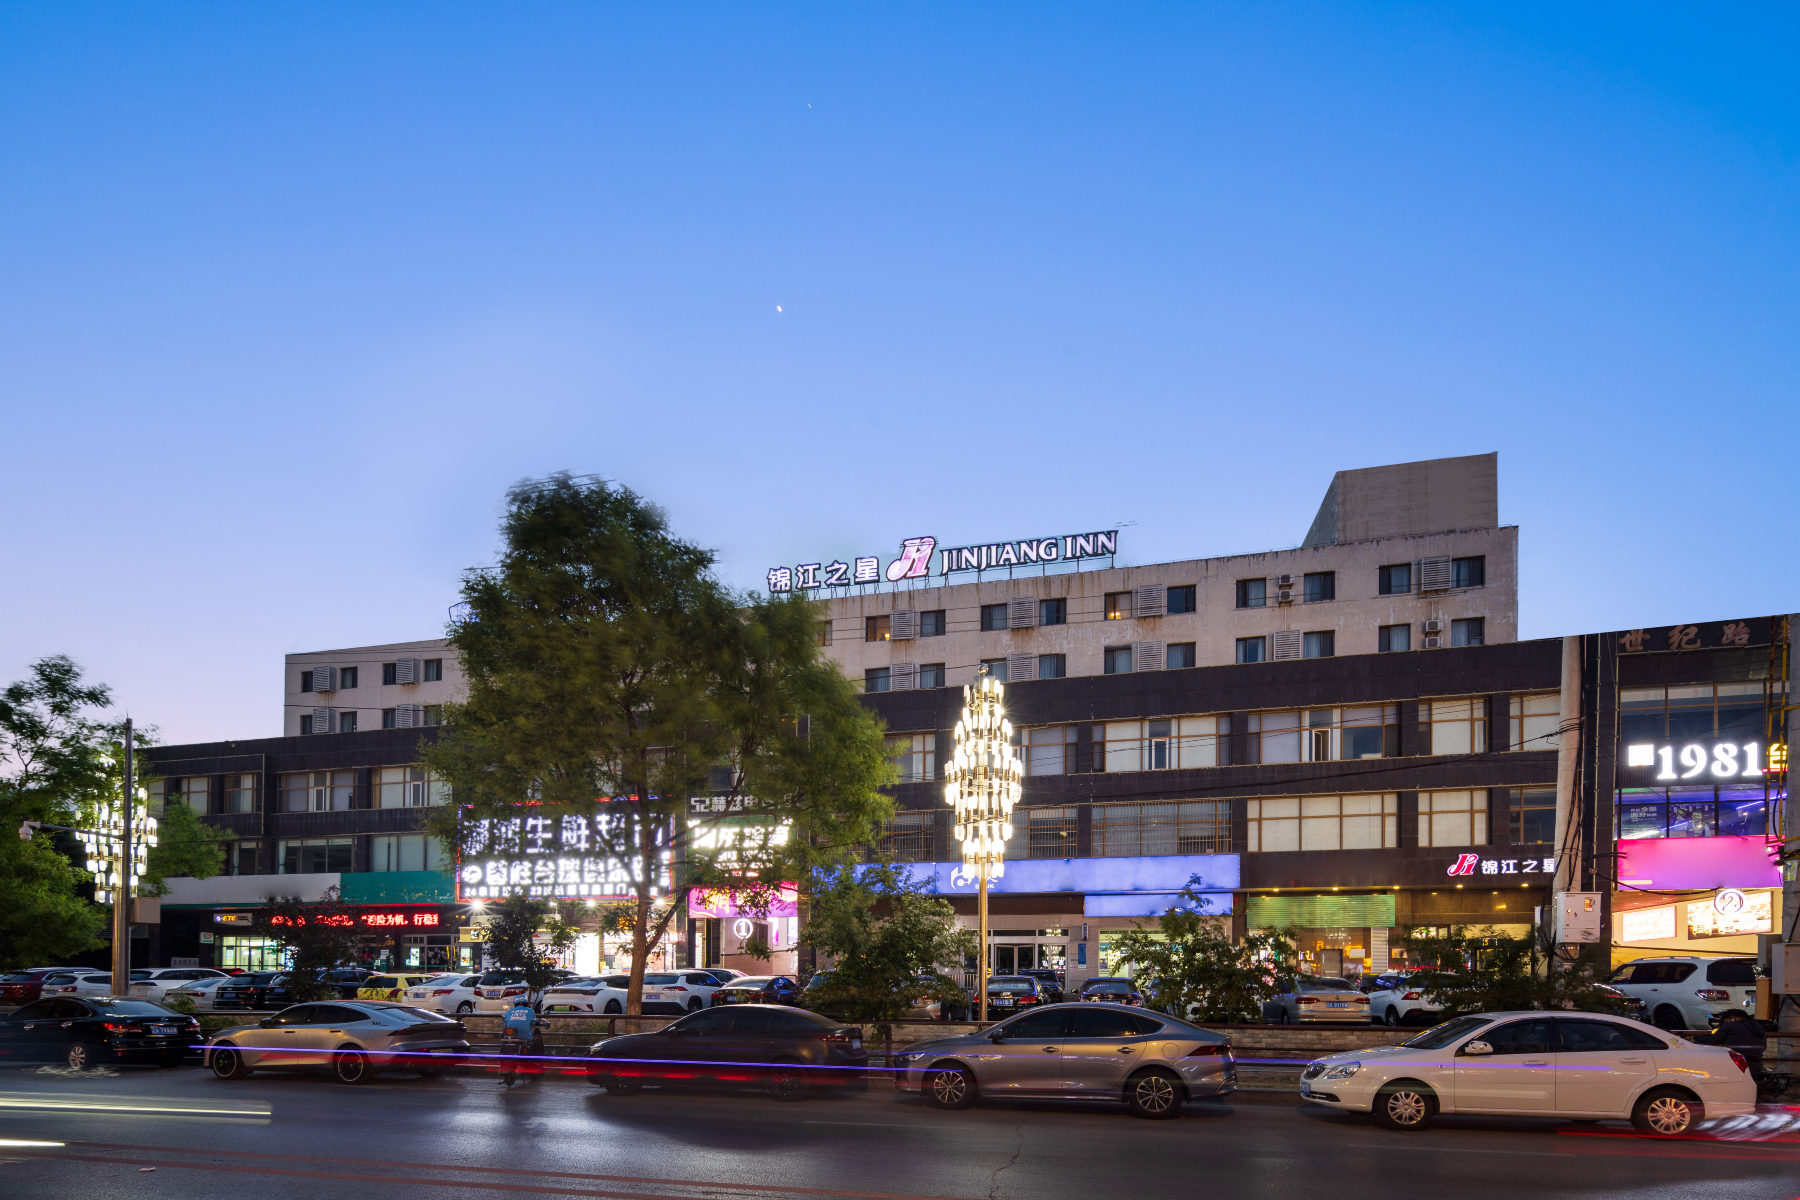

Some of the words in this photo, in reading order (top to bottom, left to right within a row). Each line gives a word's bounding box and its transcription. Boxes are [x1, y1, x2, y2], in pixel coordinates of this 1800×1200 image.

[939, 538, 1060, 575] JINJIANG
[1063, 530, 1119, 560] INN
[768, 556, 880, 594] 锦江之星
[1656, 742, 1763, 780] 1981
[1481, 858, 1556, 875] 锦江之星
